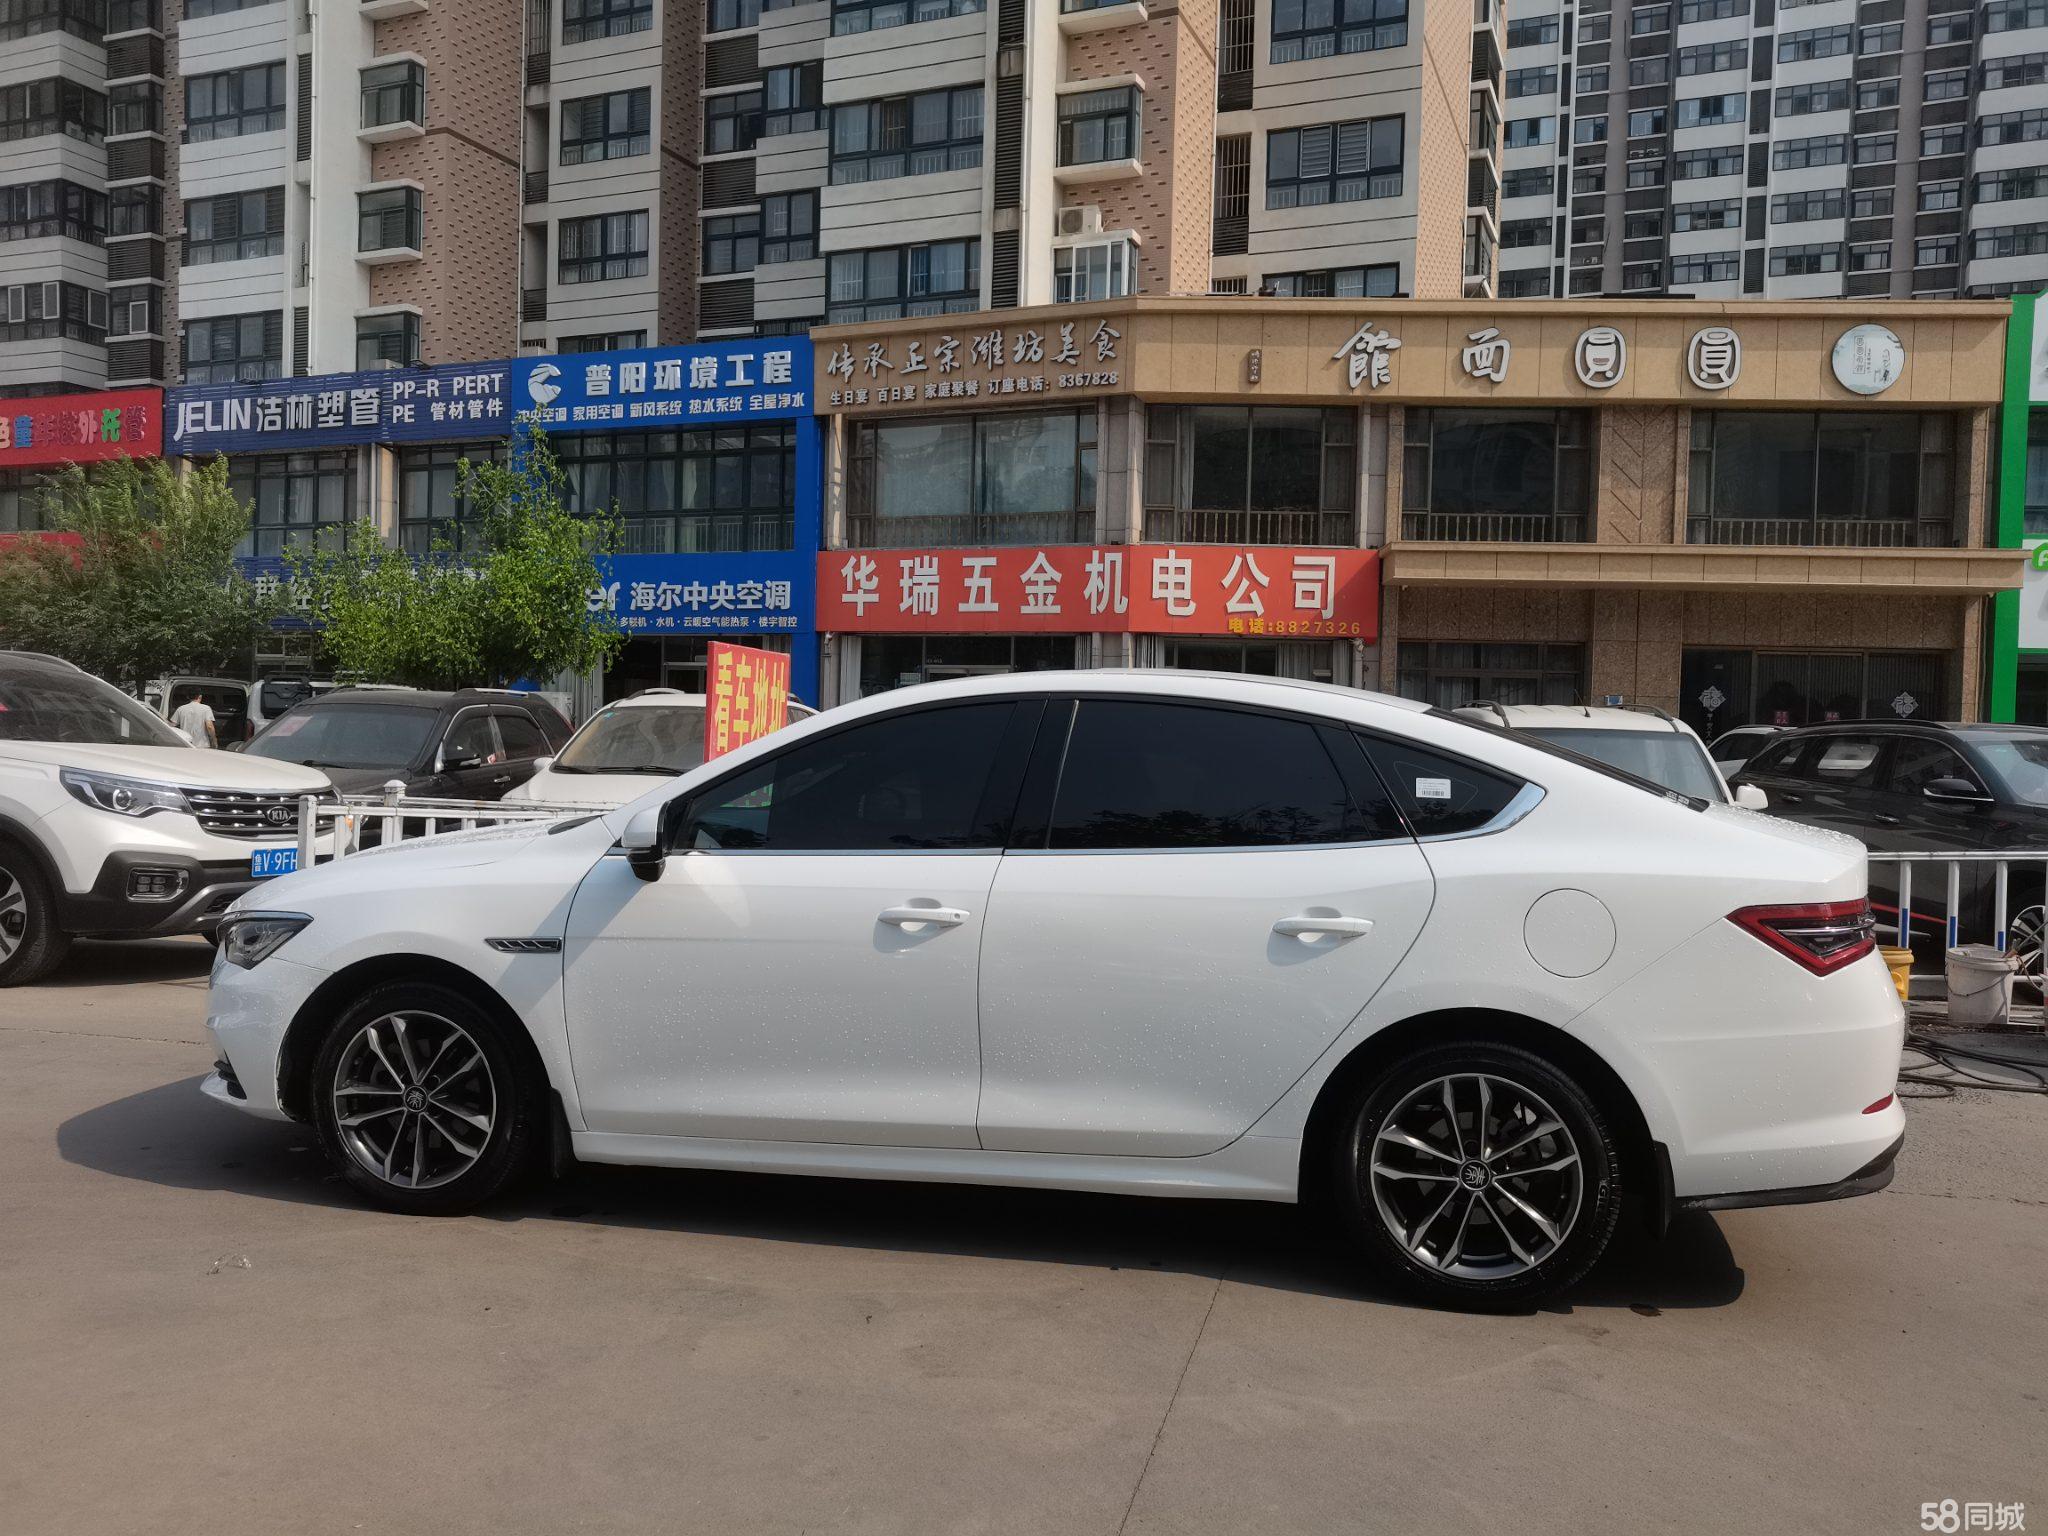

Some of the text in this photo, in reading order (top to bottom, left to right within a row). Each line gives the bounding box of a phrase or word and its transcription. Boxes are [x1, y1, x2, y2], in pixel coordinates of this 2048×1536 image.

[826, 319, 1121, 383] 传承正宗潍坊美食
[392, 373, 504, 400] PP-R PERT
[585, 350, 792, 396] 普阳环境工程
[572, 403, 624, 421] 家用空调
[629, 400, 682, 417] 新风系统
[688, 396, 743, 413] 热水系统
[749, 391, 805, 410] 全屋净水
[830, 387, 868, 406] 生日宴
[877, 384, 916, 402] 百日宴
[924, 380, 980, 399] 家庭聚餐
[173, 388, 380, 442] JELIN 洁林塑管
[392, 398, 504, 424] PE 管材管件
[630, 579, 792, 612] 海尔中央空调
[839, 550, 1338, 620] 华瑞五金机电公司
[1228, 617, 1360, 634] 电话:8827326
[271, 811, 290, 820] KIA
